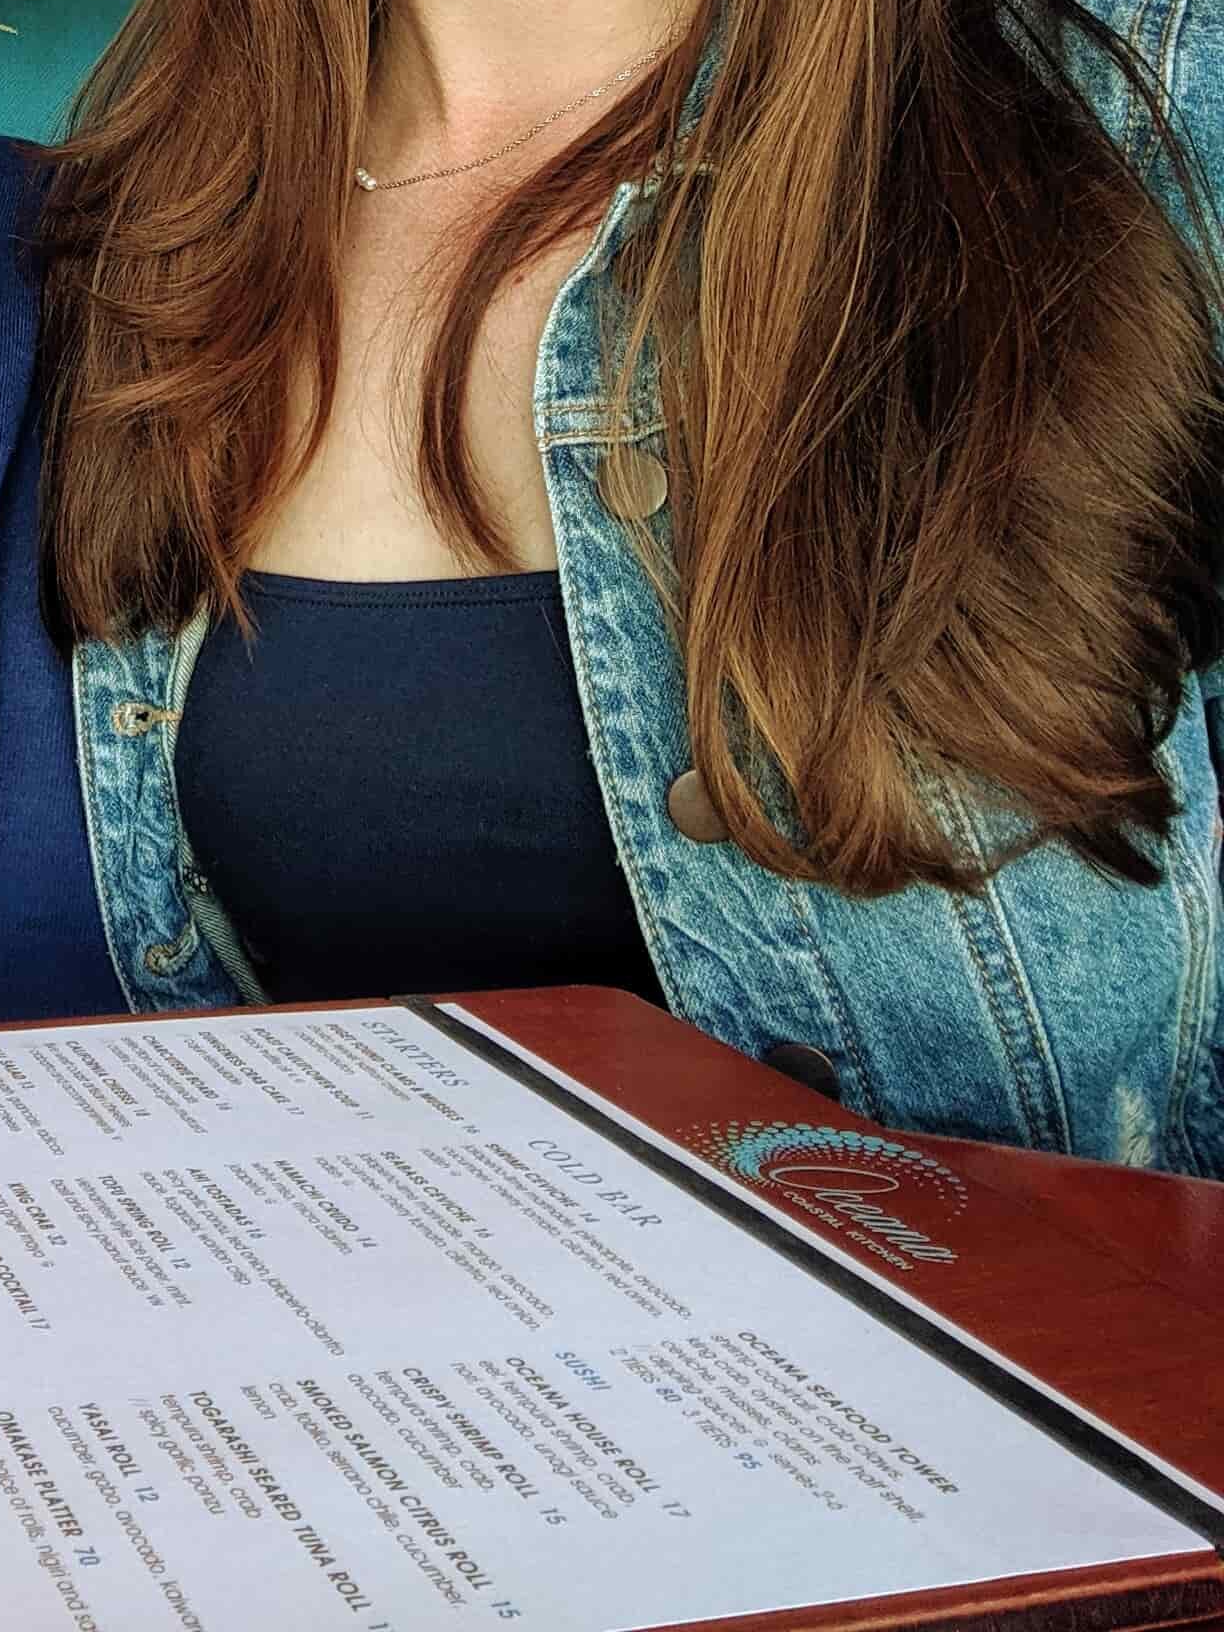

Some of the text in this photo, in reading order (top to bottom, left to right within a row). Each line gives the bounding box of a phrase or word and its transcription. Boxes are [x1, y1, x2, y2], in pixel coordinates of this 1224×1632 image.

[359, 1021, 470, 1086] STARTERS
[525, 1140, 665, 1226] COLD BAR
[784, 1191, 914, 1271] COASTAL KITCHEN
[553, 1351, 612, 1390] SUSHI
[735, 1332, 960, 1493] OCEANA SEAFOOD TOWER
[77, 1402, 160, 1502] YASAI ROLL 12
[401, 1368, 568, 1524] CRISPY SHRIMP ROLL 15
[504, 1357, 692, 1517] OCEANA HOUSE ROLL 17
[33, 1481, 84, 1536] PLATTER
[72, 1546, 101, 1565] 70
[187, 1391, 372, 1611] TOGARASHI SEARED TUNA ROLL
[295, 1379, 521, 1618] SMOKED SALMON CITRUS ROLL 15
